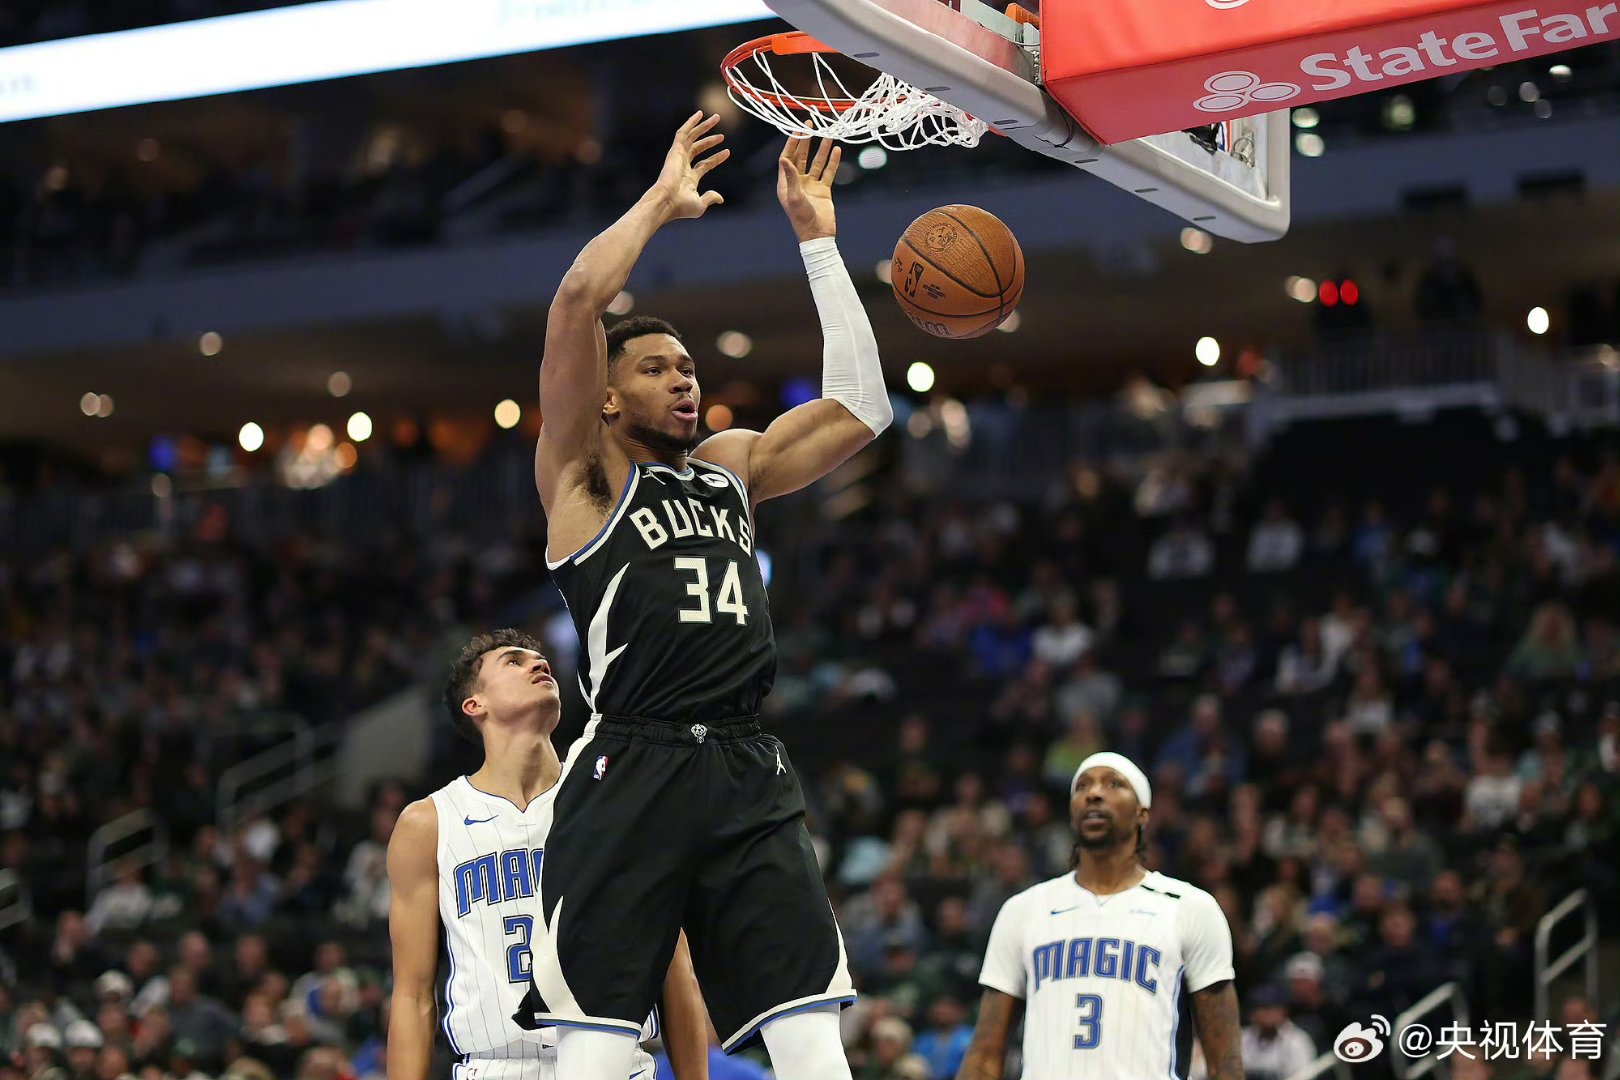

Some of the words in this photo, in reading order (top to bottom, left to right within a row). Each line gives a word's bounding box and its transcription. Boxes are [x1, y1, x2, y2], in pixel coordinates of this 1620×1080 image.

[1499, 2, 1620, 52] Far
[629, 498, 752, 557] BUCKS
[674, 555, 750, 626] 34
[1033, 938, 1161, 995] MAGIC
[1072, 993, 1103, 1050] 3
